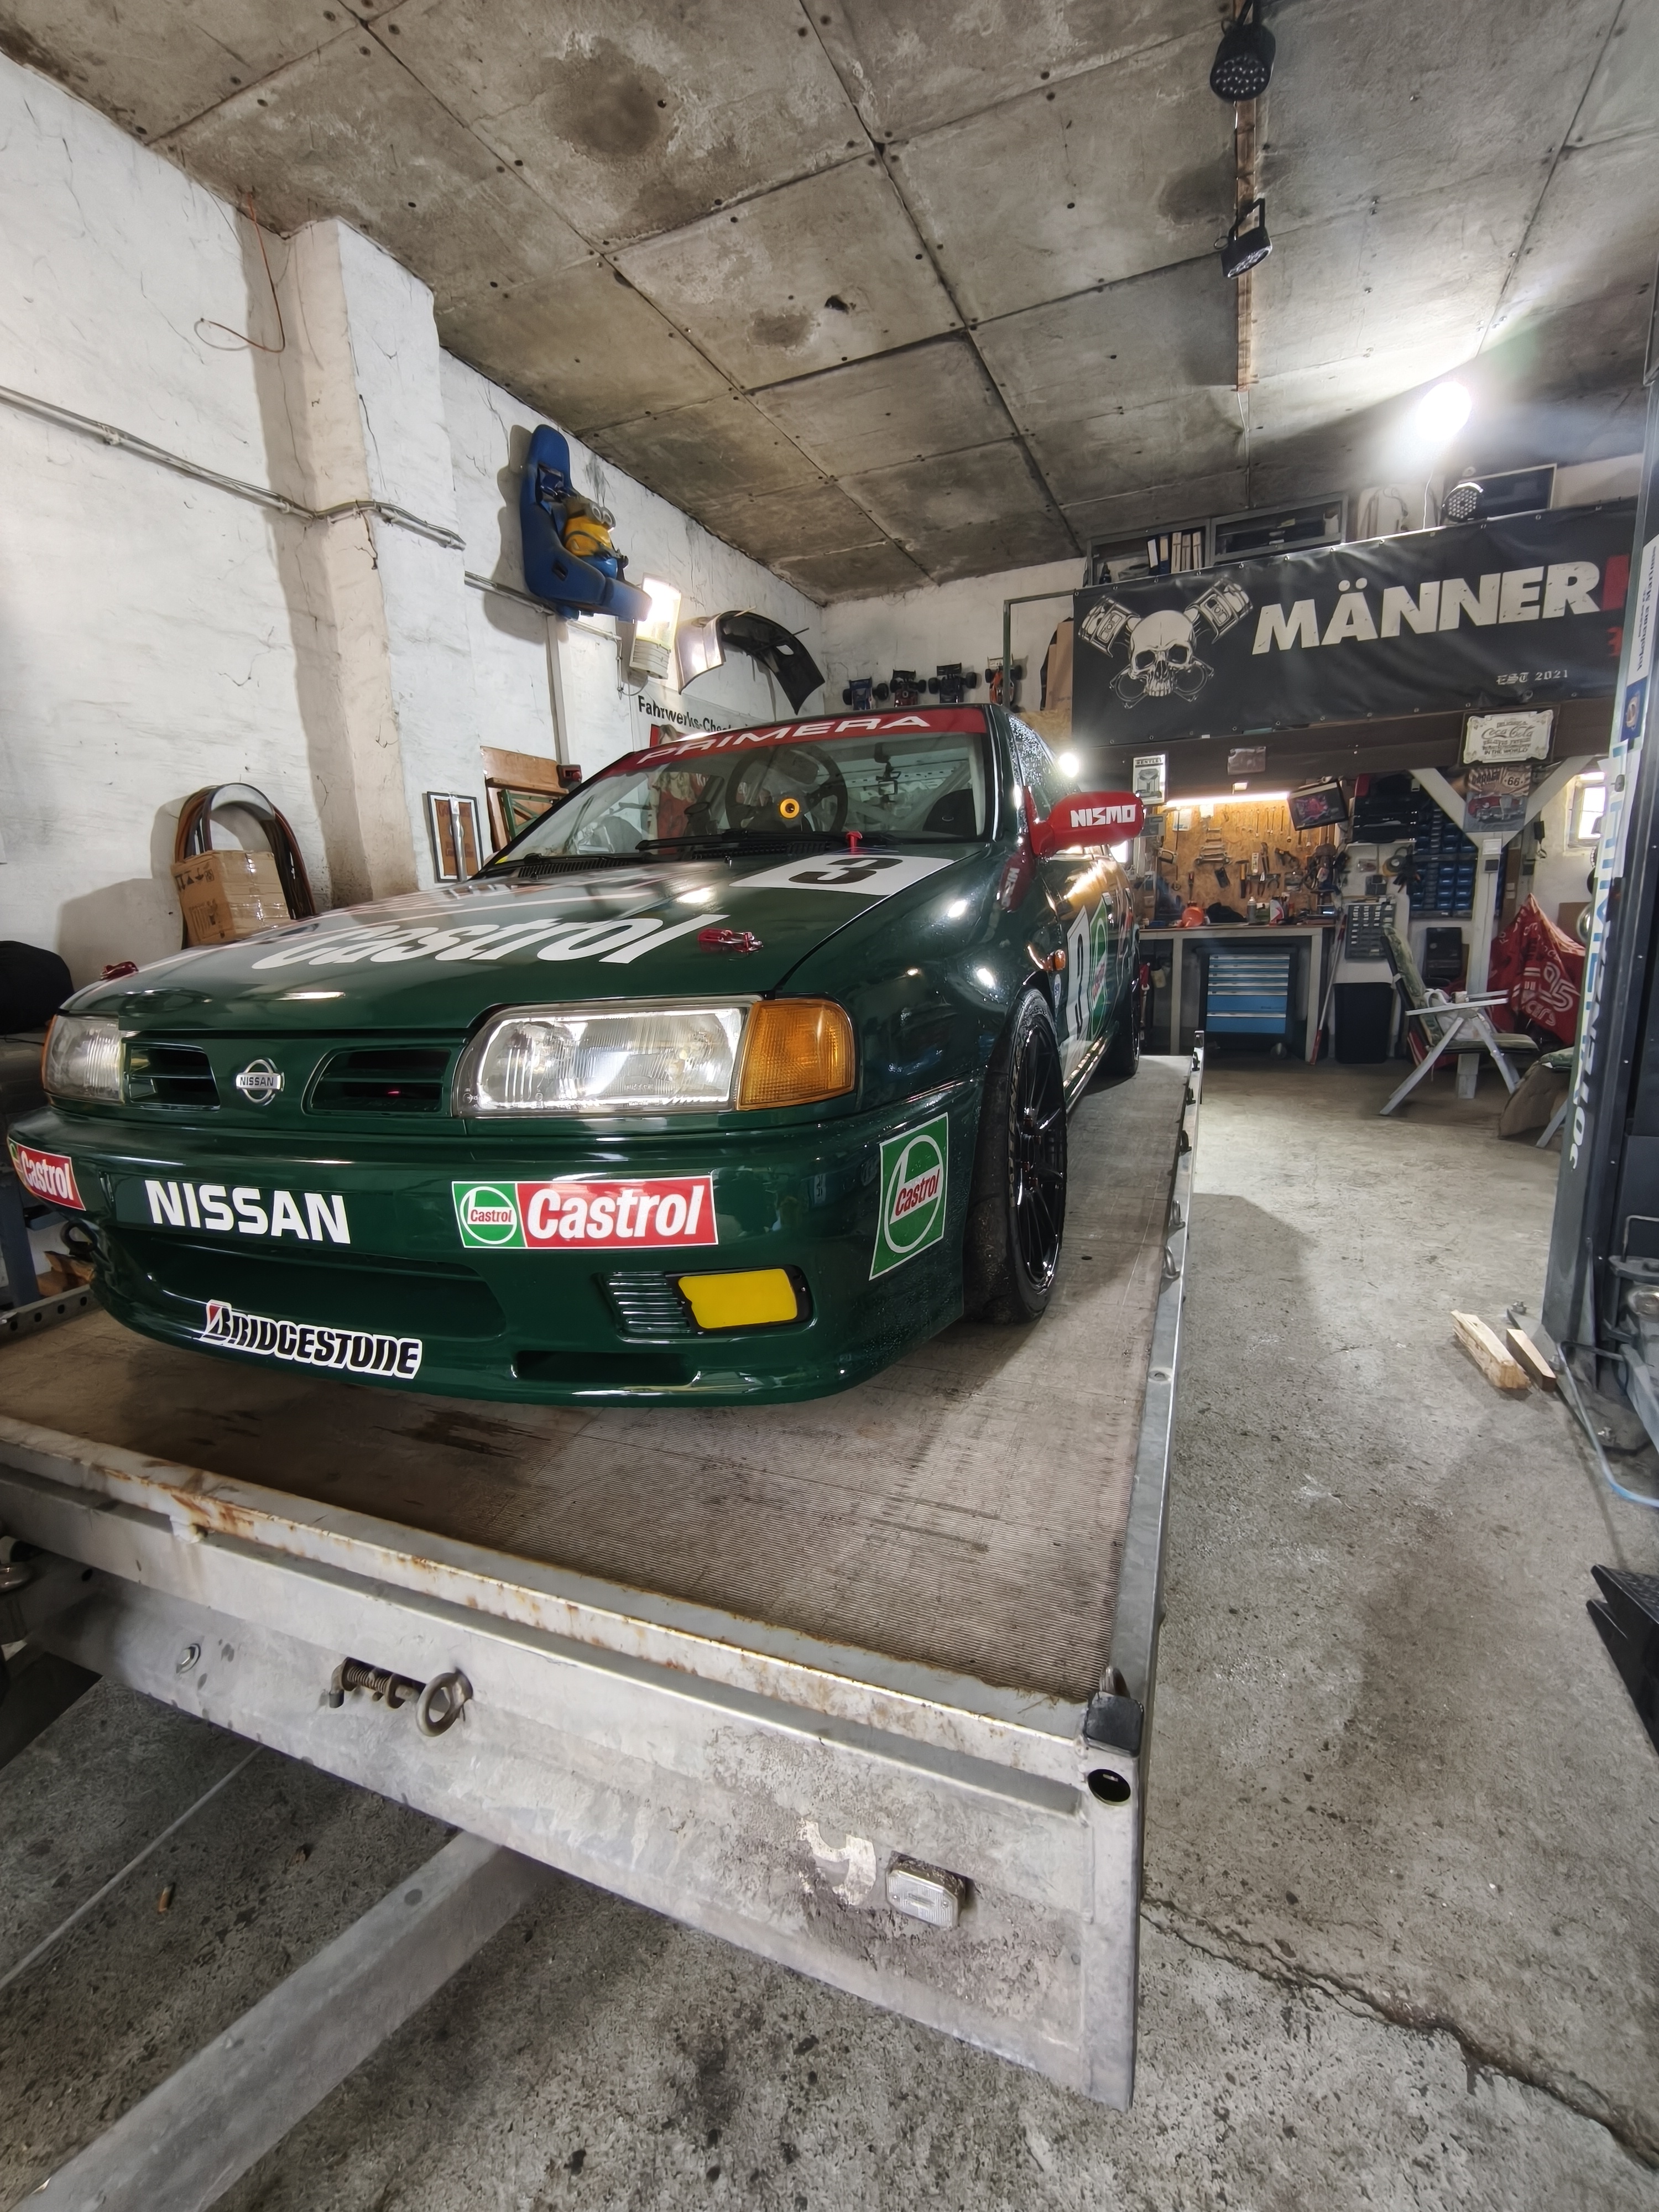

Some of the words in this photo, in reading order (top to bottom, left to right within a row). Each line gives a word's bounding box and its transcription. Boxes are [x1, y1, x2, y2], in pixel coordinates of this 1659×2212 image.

[1252, 555, 1629, 655] MÄNNER
[1496, 672, 1529, 685] EST
[1535, 670, 1568, 681] 2021
[638, 695, 731, 732] Fahrwerks-Che
[637, 716, 930, 765] PRIMERA
[1507, 776, 1521, 786] 66
[1071, 805, 1136, 827] NISMO
[789, 857, 904, 885] 3
[252, 914, 730, 969] Castrol
[240, 1077, 274, 1086] NISSAN
[21, 1150, 74, 1201] Castrol
[895, 1168, 940, 1216] Castrol
[144, 1180, 351, 1244] NISSAN
[470, 1208, 512, 1223] Castrol
[527, 1185, 705, 1239] Castrol
[202, 1301, 419, 1376] BRIDGESTONE
